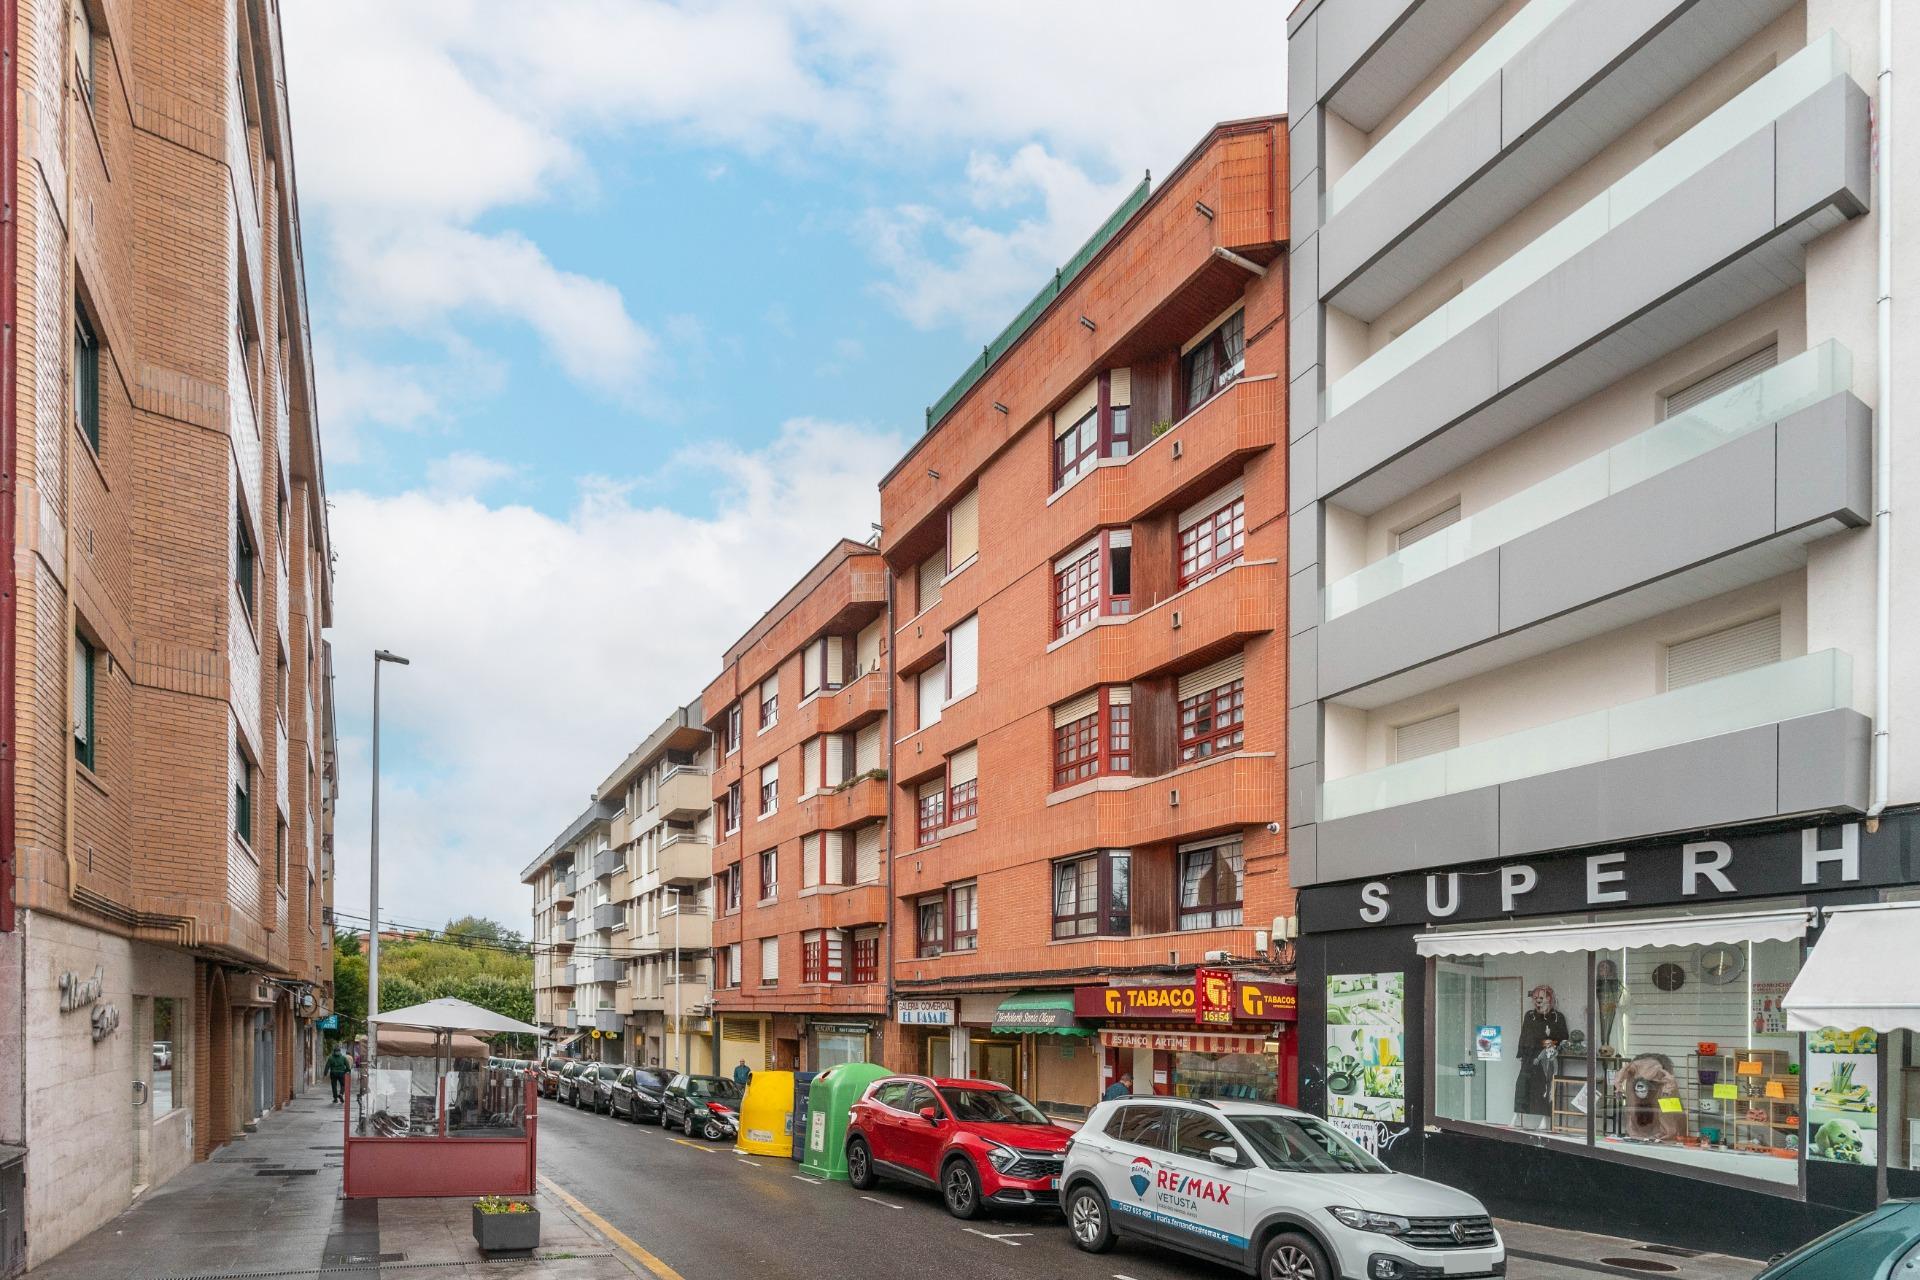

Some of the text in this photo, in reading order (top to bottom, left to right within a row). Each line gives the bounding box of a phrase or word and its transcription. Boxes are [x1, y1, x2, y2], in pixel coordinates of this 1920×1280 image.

[899, 1001, 954, 1011] GALERIA COMERCIAL
[1264, 995, 1296, 1005] TABACOS
[903, 1011, 948, 1023] EL PASAJE
[1203, 1010, 1229, 1022] 16:54
[1112, 1035, 1188, 1048] ESTANCO ARTIME
[1157, 1170, 1231, 1205] RE/MAX
[1157, 1192, 1198, 1211] VETUSTA
